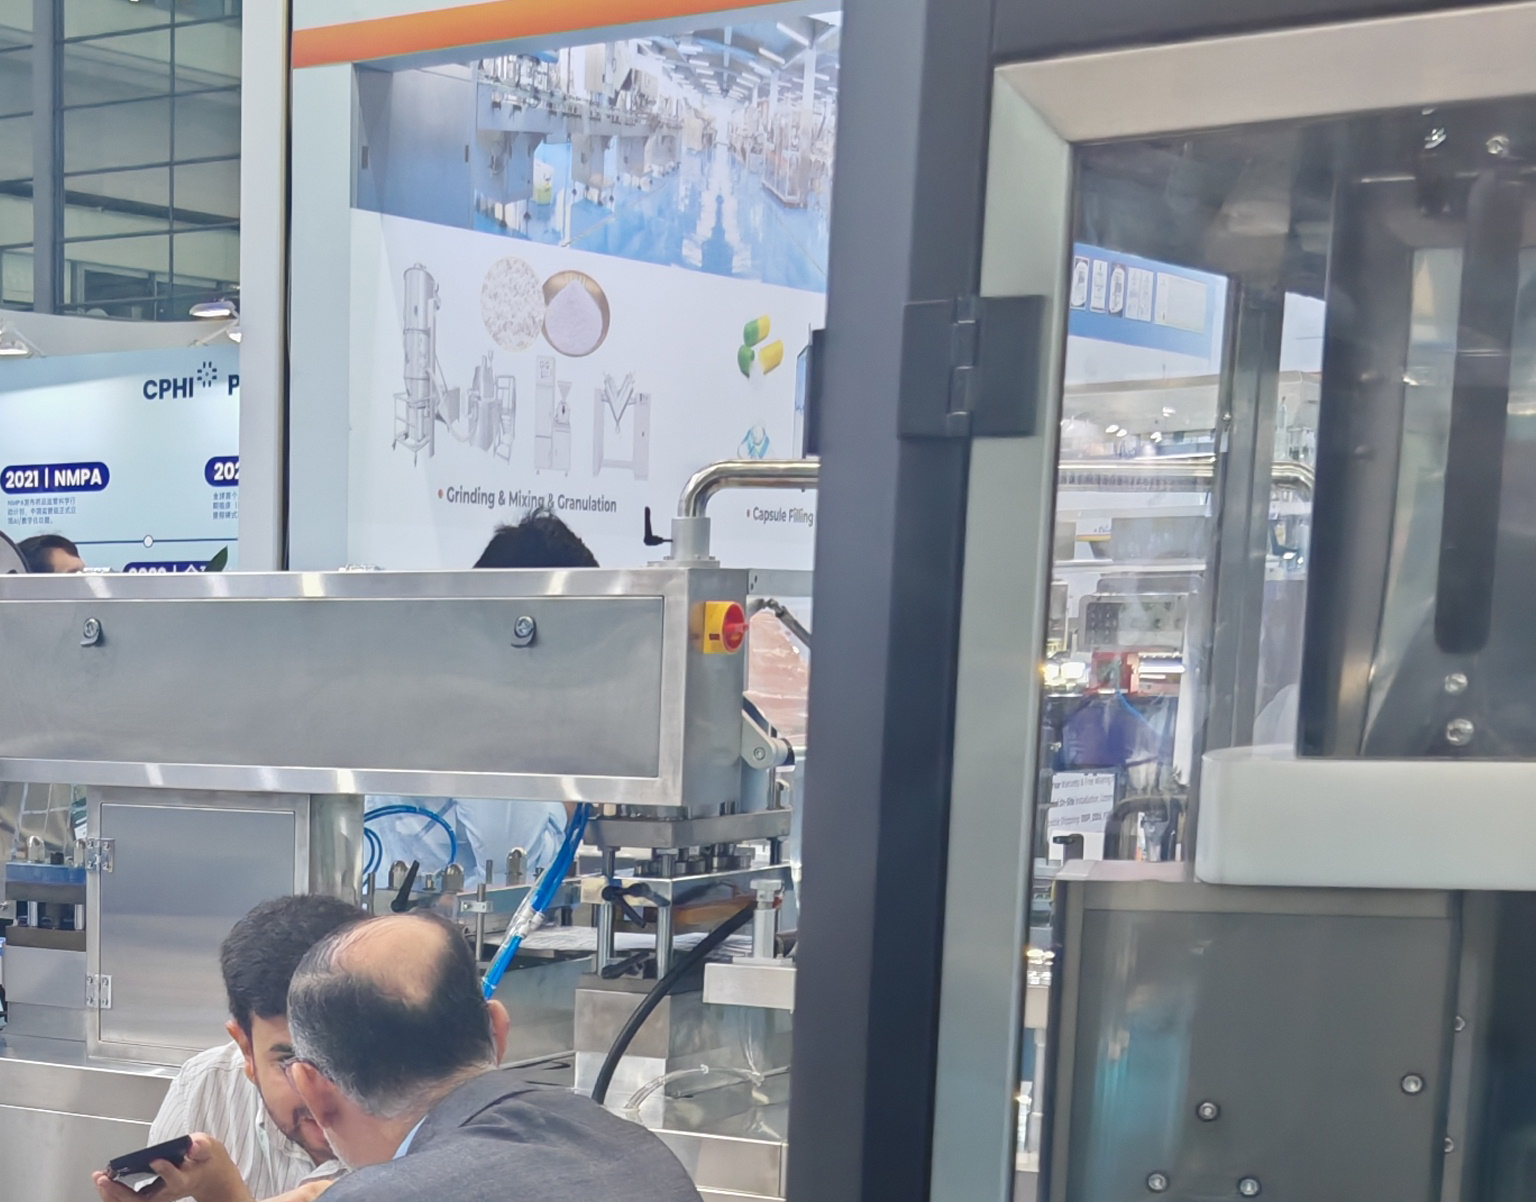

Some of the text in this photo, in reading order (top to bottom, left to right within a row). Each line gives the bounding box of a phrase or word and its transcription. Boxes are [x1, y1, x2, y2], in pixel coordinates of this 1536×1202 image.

[143, 377, 194, 400] CPHI
[5, 467, 103, 489] 2021 NMPA
[446, 485, 495, 509] Grinding
[498, 490, 506, 506] &
[508, 490, 545, 508] Mixing
[557, 494, 617, 513] Granulation
[752, 506, 814, 527] Capsule Filling
